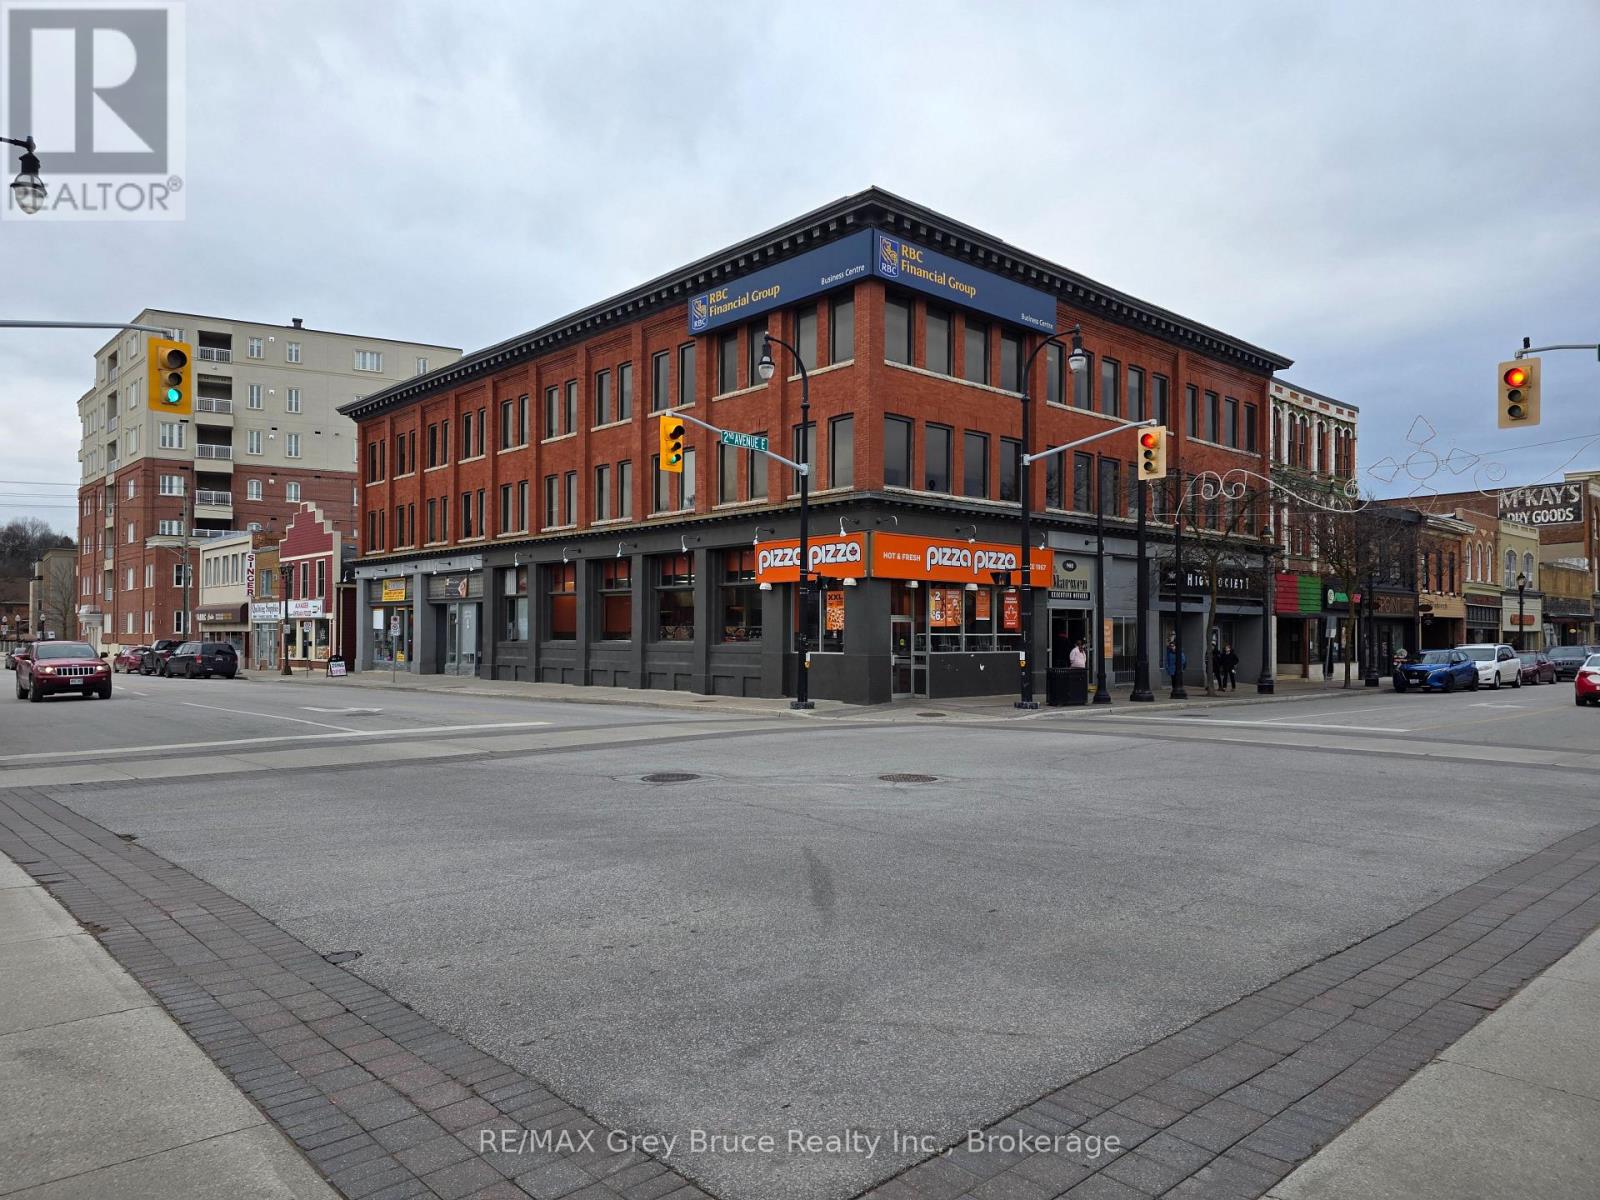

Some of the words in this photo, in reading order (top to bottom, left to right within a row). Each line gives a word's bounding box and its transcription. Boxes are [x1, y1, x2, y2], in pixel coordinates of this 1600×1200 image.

[901, 244, 923, 263] RBC
[821, 271, 844, 286] Business
[845, 264, 865, 277] Centre
[881, 262, 897, 275] RBC
[901, 259, 946, 285] Financial
[948, 276, 976, 298] Group
[709, 287, 728, 304] RBC
[709, 292, 749, 317] Financial
[751, 283, 780, 302] Group
[693, 319, 705, 328] RBC
[1021, 312, 1039, 325] Business
[734, 434, 759, 449] AVENUE
[761, 438, 766, 450] E
[1499, 484, 1580, 509] McKAY'S
[1506, 511, 1530, 524] DRY
[1532, 507, 1574, 523] GOODS
[808, 542, 861, 572] pizza
[883, 551, 896, 560] HOT
[902, 553, 920, 562] FRESH
[926, 546, 972, 572] pizza
[974, 550, 1016, 575] pizza
[247, 554, 255, 596] SINGER
[1217, 577, 1249, 590] OCIETY
